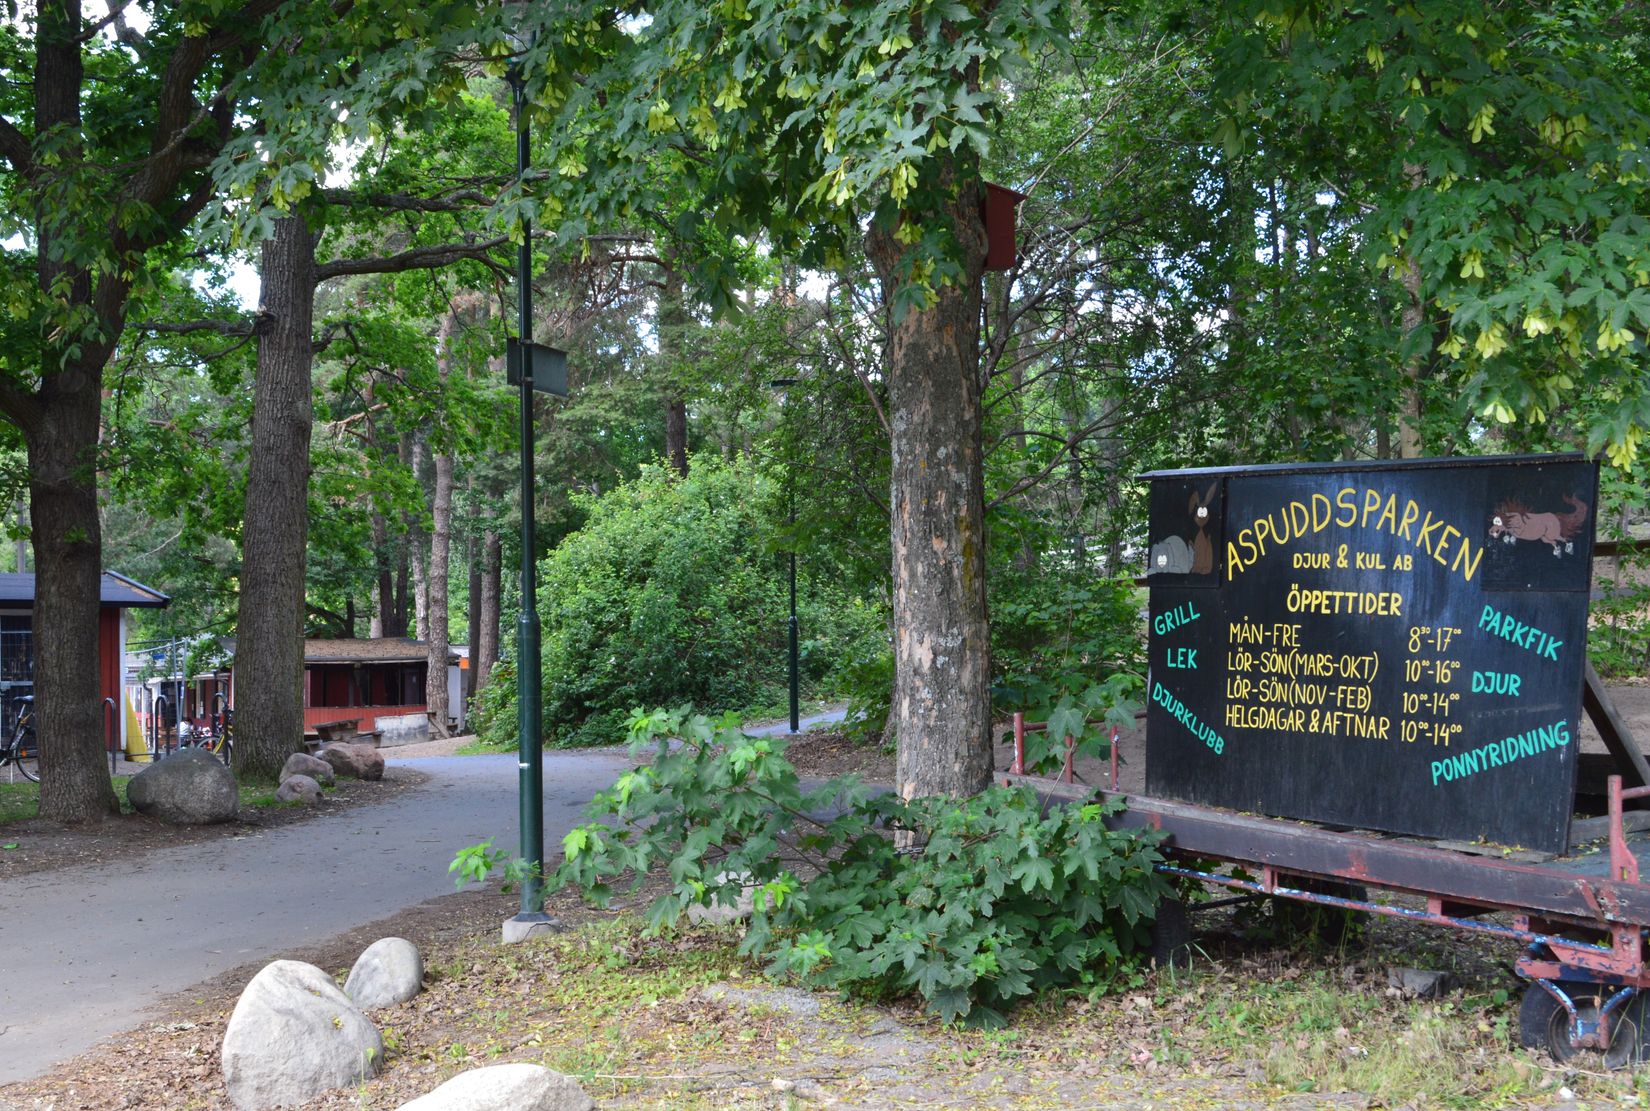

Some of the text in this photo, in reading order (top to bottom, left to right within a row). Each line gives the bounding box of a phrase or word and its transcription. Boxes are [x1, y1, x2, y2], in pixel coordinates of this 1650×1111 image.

[1227, 487, 1484, 582] ASPUDDSPARKEN
[1293, 543, 1413, 571] DJUR & KUL AB
[1286, 583, 1403, 616] ÖPPETTIDER
[1154, 601, 1201, 636] GRILL
[1229, 616, 1302, 648] MÅN-FRE
[1478, 604, 1564, 661] PARKFIK
[1167, 647, 1198, 670] LEK
[1471, 671, 1522, 697] DJUR
[1152, 681, 1225, 756] DJURKLUBB
[1225, 704, 1306, 733] HELGDAGAR
[1308, 708, 1321, 733] &
[1321, 711, 1391, 740] AFTNAR
[1431, 720, 1570, 786] PONNYRIDNING
